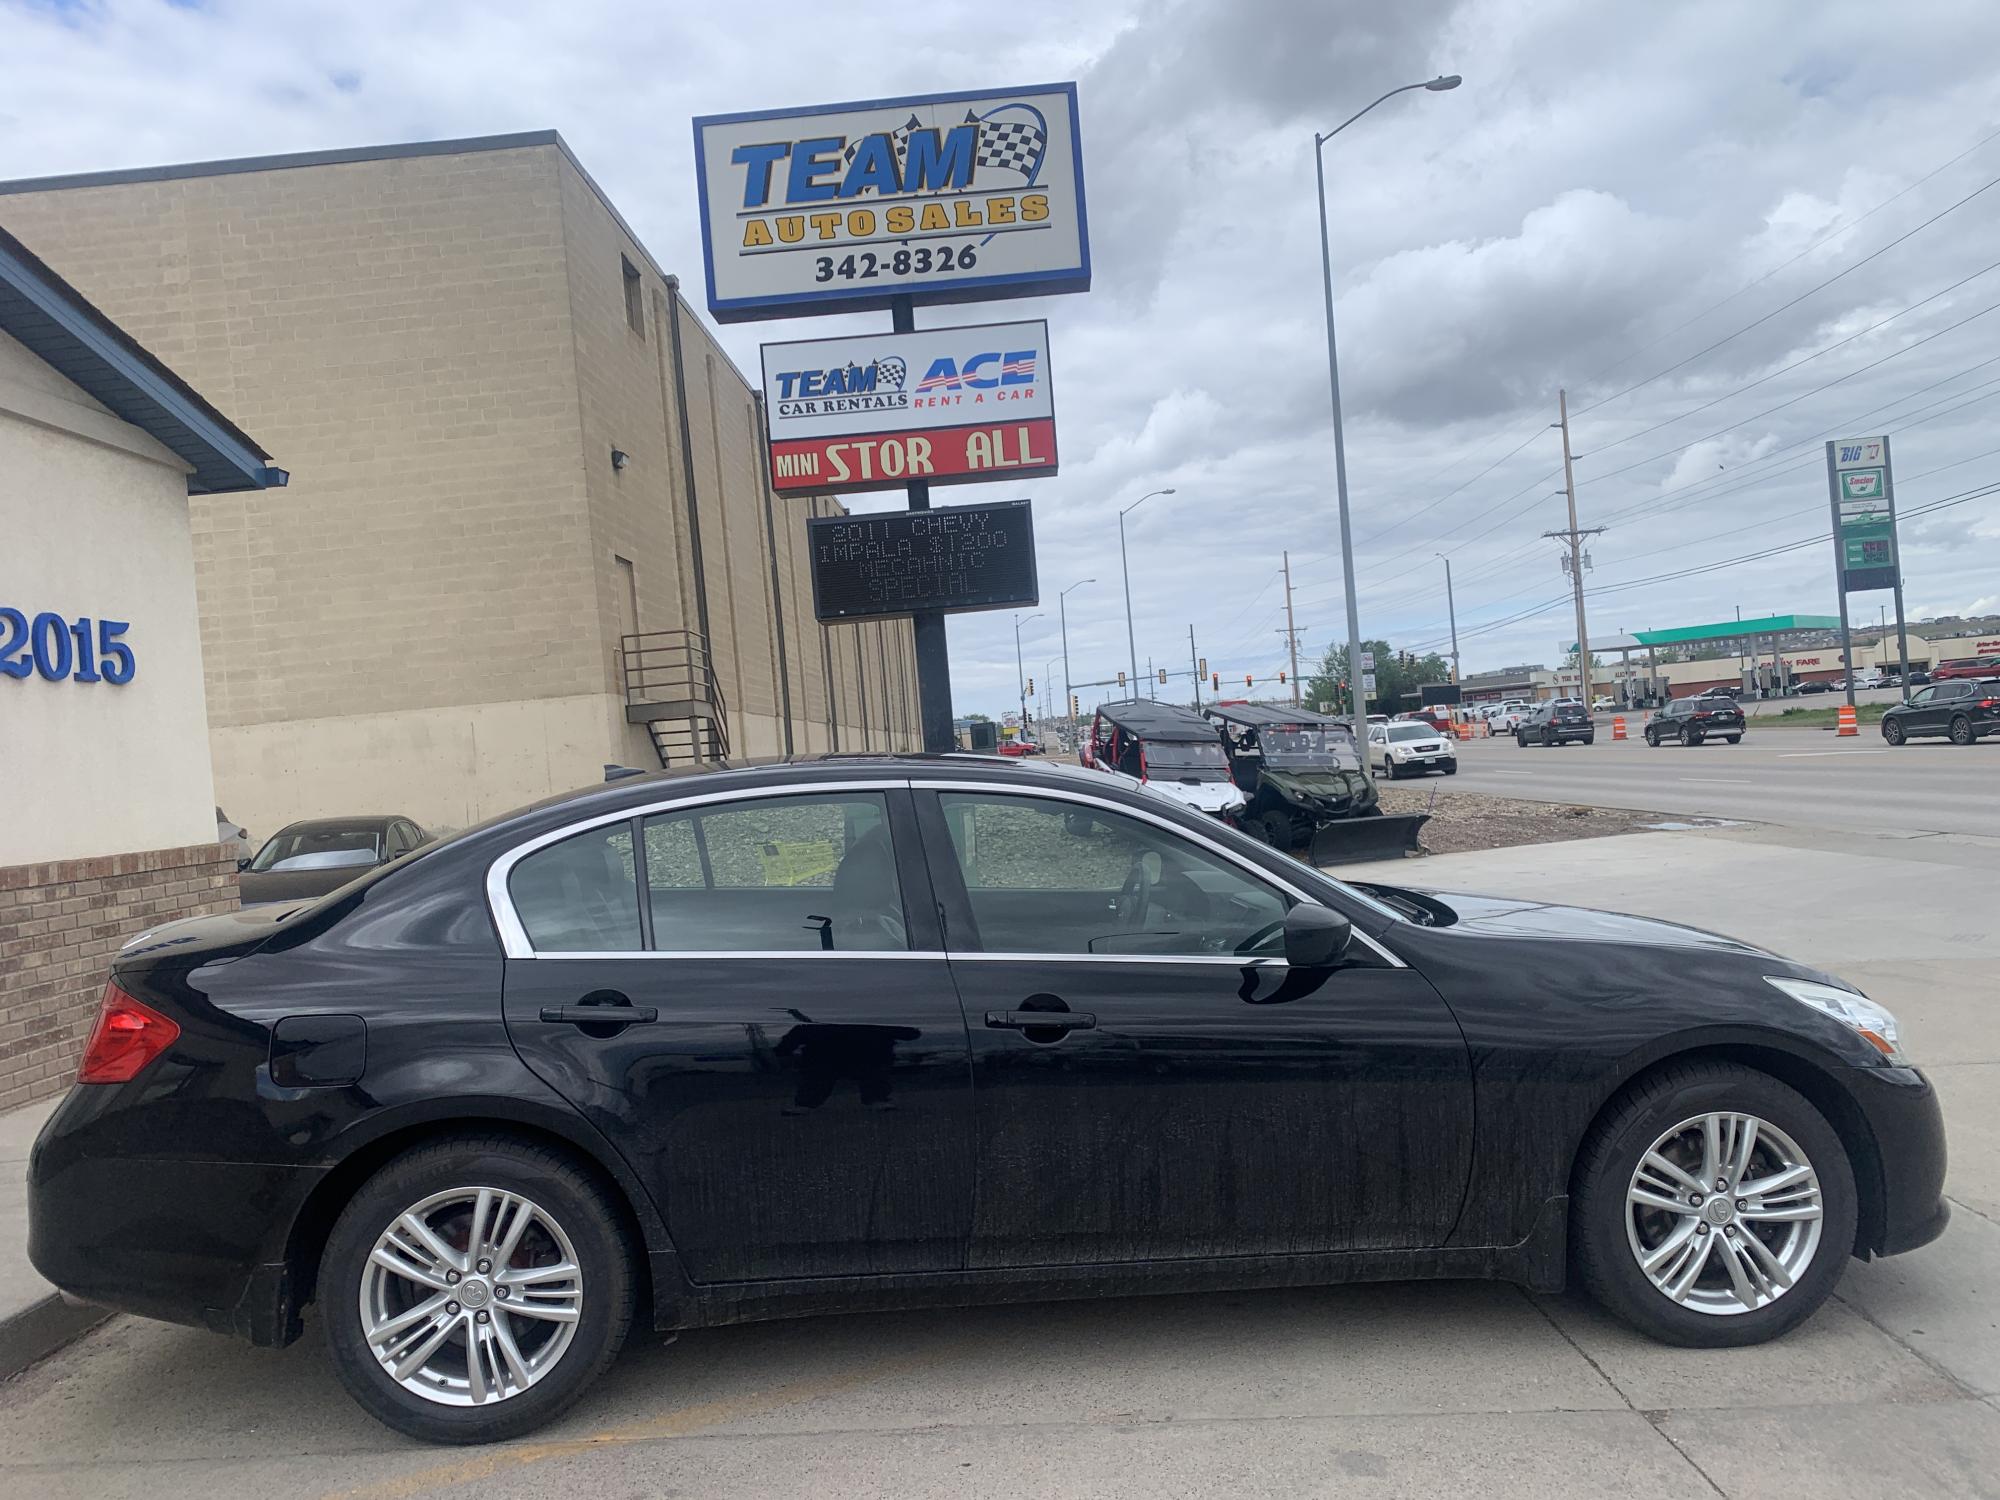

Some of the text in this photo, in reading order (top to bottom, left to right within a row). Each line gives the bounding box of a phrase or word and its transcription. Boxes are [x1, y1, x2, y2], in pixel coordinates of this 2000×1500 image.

[731, 123, 980, 208] TEAM
[815, 244, 977, 283] 342-8326
[776, 365, 878, 399] TEAM
[915, 350, 1037, 393] ACE
[780, 394, 908, 415] CAR RENTALS
[914, 389, 1035, 408] RENT A CAR
[776, 427, 1046, 482] MINI STOR ALL
[1840, 446, 1862, 463] BIG
[1850, 476, 1875, 485] Sinclair
[832, 513, 989, 543] 2011 CHEVY
[821, 530, 1007, 563] IMPALA $1200
[869, 572, 979, 601] SPECIAL
[0, 607, 136, 685] 2015
